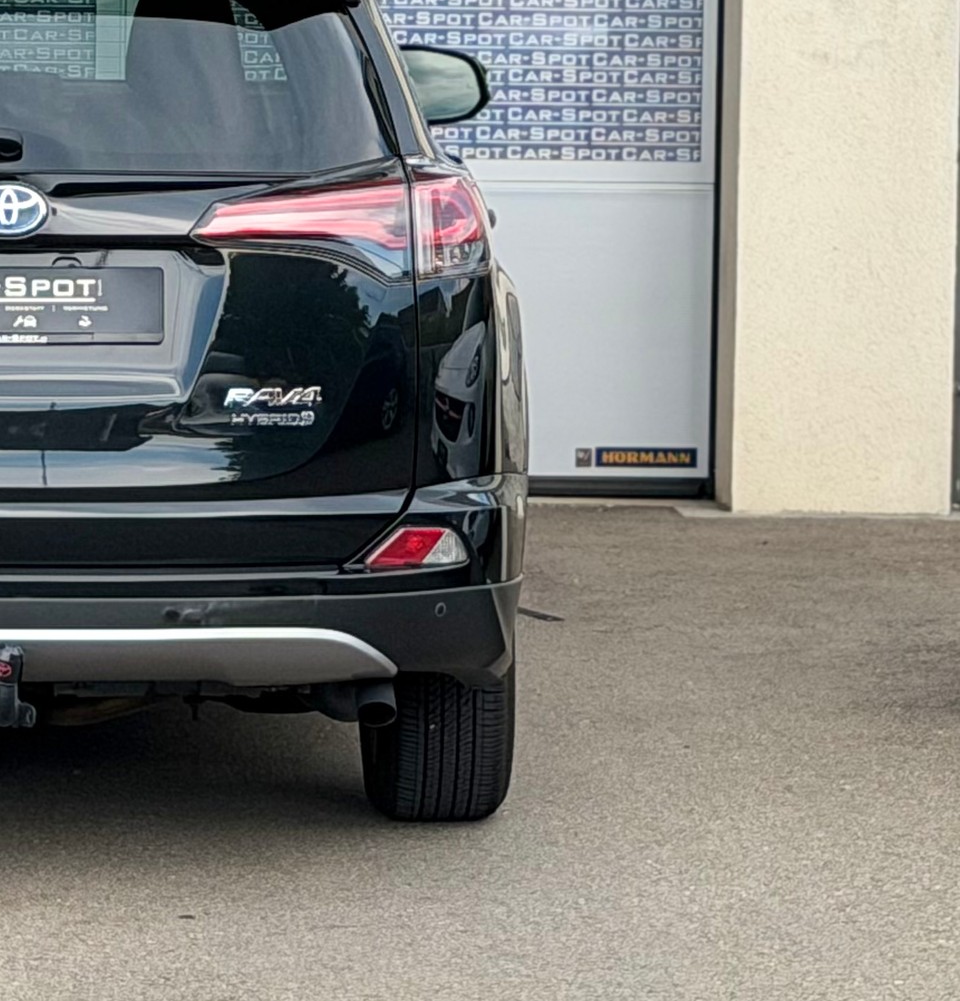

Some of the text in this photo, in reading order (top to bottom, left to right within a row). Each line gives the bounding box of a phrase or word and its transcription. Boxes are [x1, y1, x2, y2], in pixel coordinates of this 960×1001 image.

[478, 14, 590, 27] CAR-SPOT
[509, 33, 621, 46] CAR-SPOT
[477, 52, 590, 65] CAR-SPOT
[508, 69, 620, 82] CAR-SPOT
[508, 108, 620, 121] CAR-SPOT
[476, 127, 589, 140] CAR-SPOT
[507, 148, 619, 161] CAR-SPOT
[223, 386, 322, 407] RAV4
